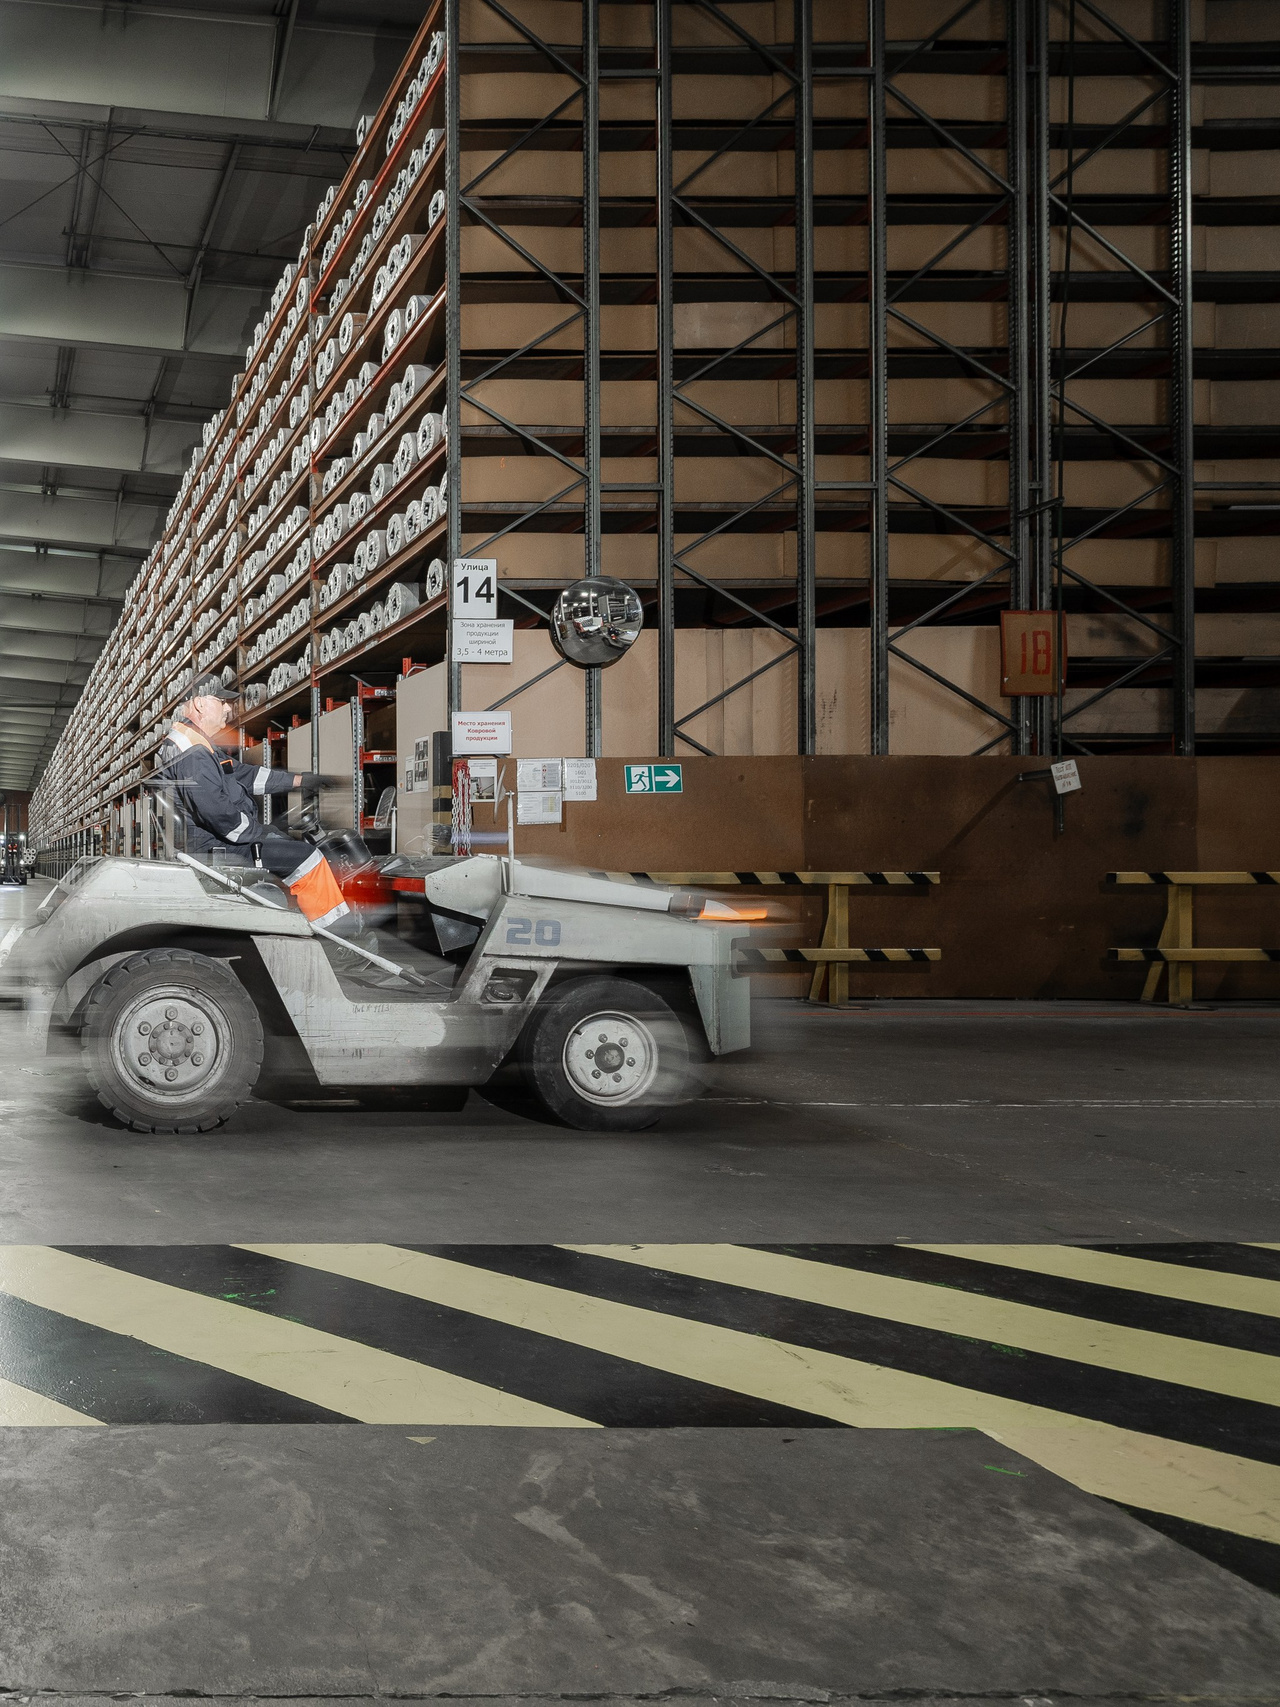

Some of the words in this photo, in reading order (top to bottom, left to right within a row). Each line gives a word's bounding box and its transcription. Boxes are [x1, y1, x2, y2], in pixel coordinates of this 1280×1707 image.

[461, 563, 489, 572] Улица
[457, 576, 495, 604] 14
[456, 647, 469, 657] 3,5
[476, 648, 482, 656] 4
[484, 649, 508, 657] метра
[1021, 630, 1051, 675] 18
[505, 916, 562, 947] 20
